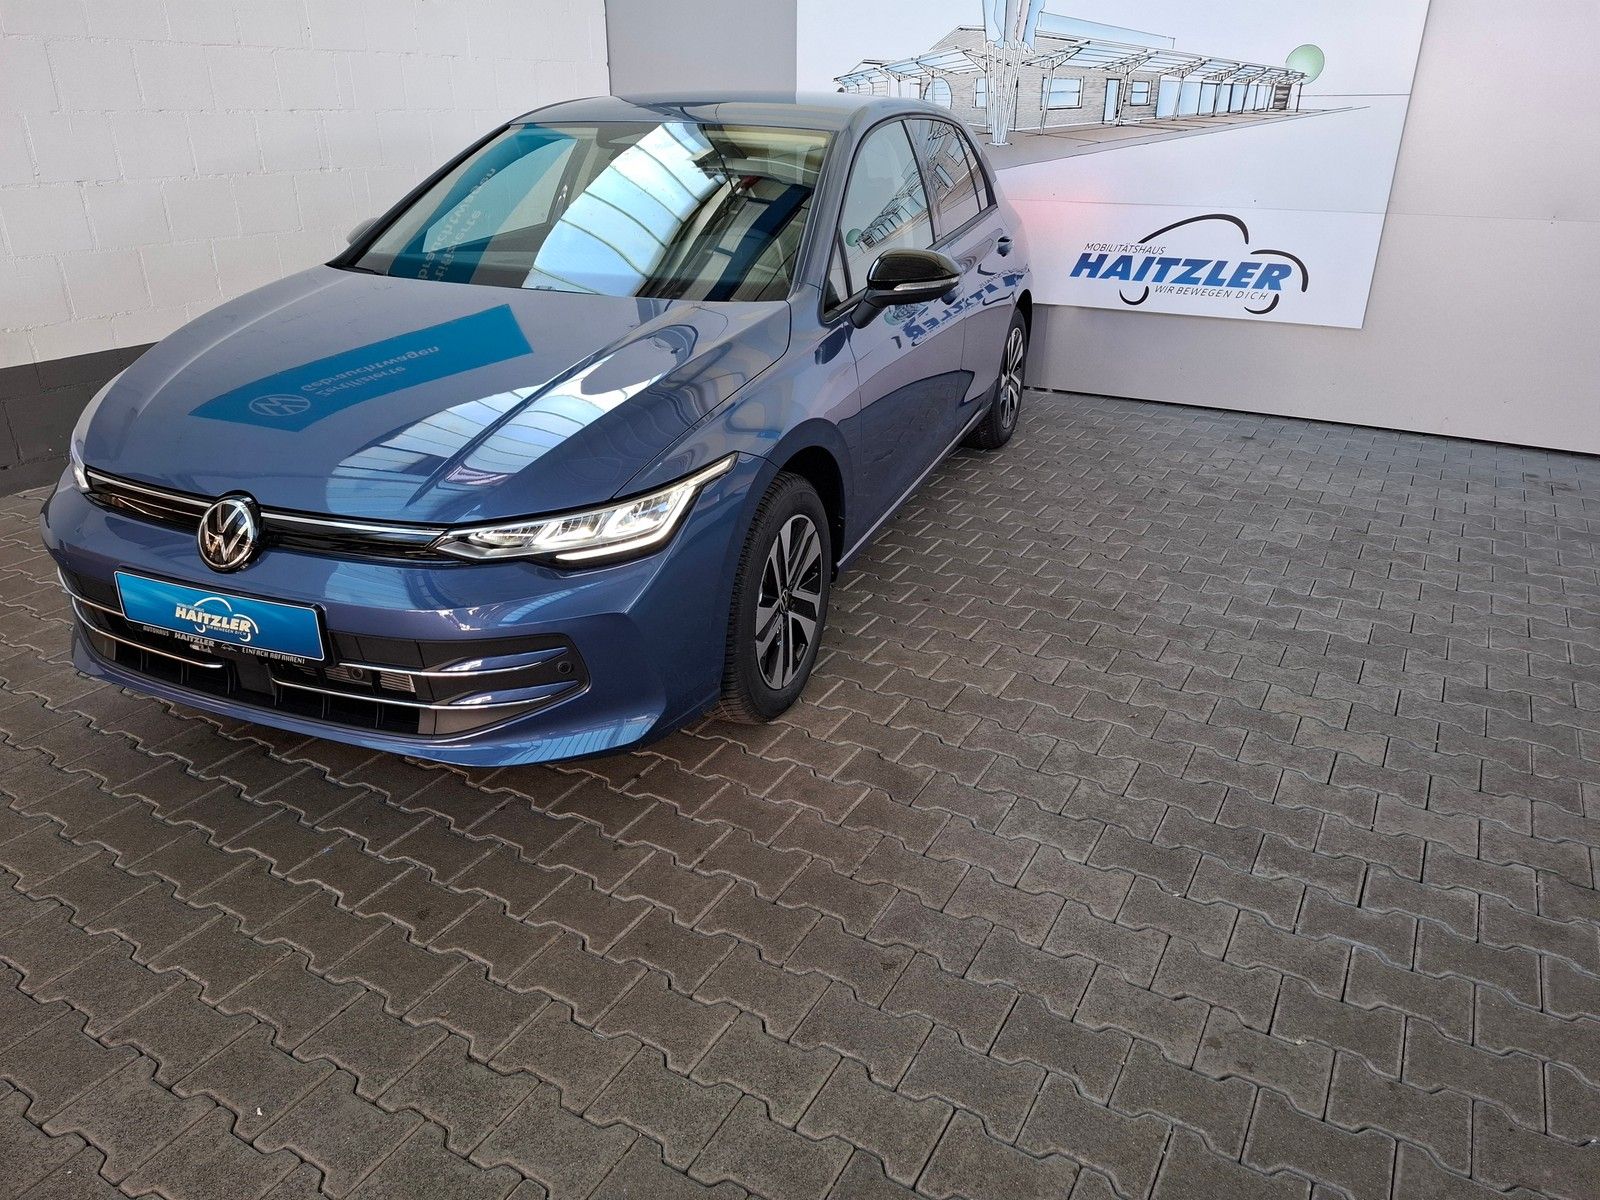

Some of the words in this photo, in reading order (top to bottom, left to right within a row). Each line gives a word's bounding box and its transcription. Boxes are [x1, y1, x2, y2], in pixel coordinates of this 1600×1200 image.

[1084, 242, 1167, 256] MOBILITÄTSHAUS
[1069, 252, 1293, 292] HAITZLER
[1154, 285, 1175, 295] WIR
[1176, 286, 1232, 299] BEWEGEN
[1235, 290, 1269, 301] DICH
[175, 606, 252, 633] HAITZLER
[174, 631, 215, 647] HAITZLER
[241, 647, 269, 659] EINFACH
